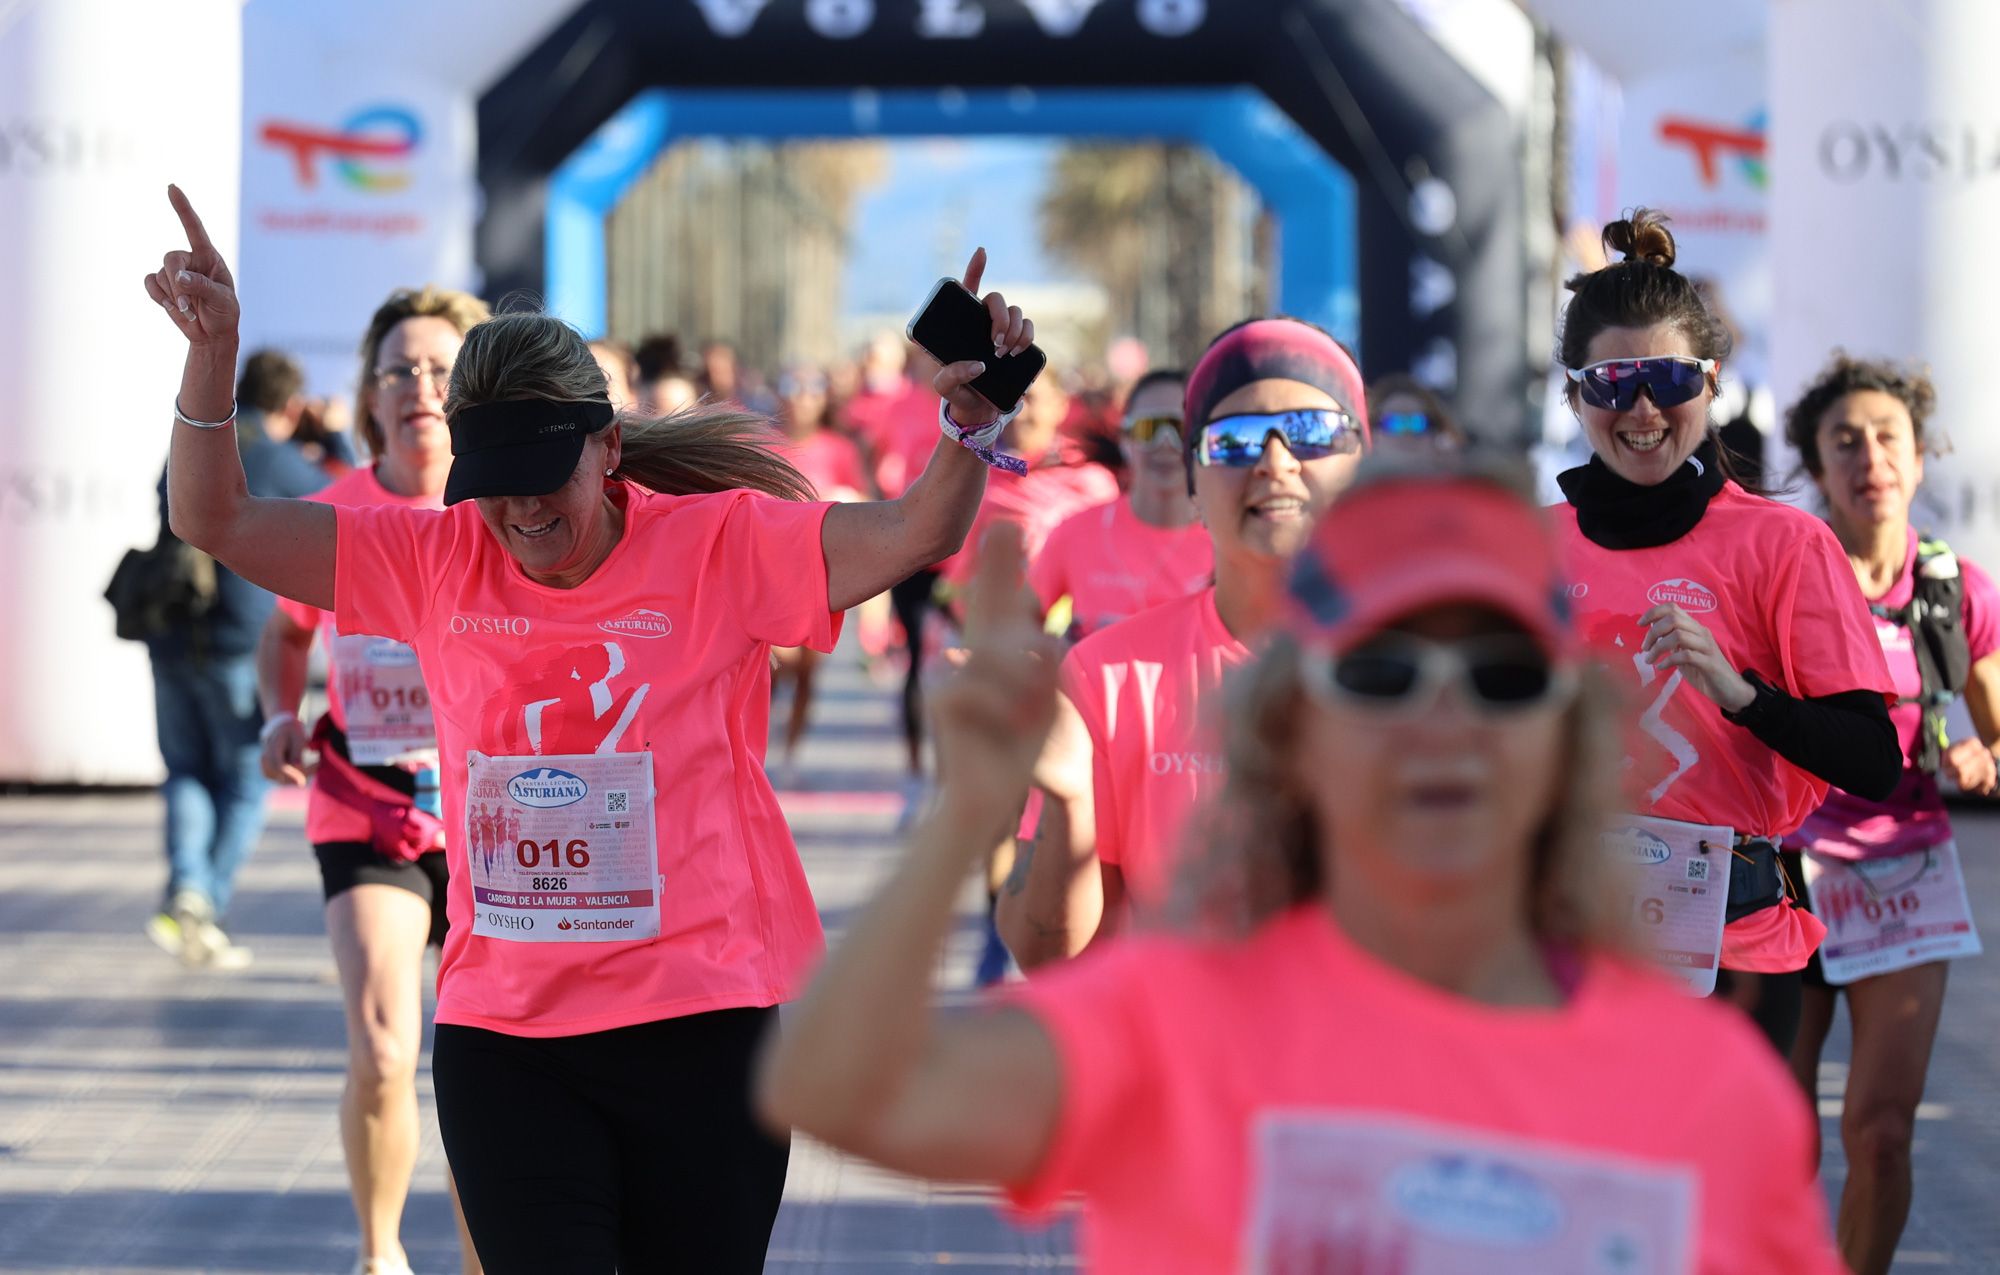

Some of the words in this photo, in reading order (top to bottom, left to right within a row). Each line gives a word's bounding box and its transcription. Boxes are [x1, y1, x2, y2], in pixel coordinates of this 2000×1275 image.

[1653, 588, 1711, 608] ASTURIANA
[450, 616, 530, 635] OYSHO
[604, 620, 666, 632] ASTURIANA
[371, 688, 428, 711] 016
[1150, 752, 1224, 775] OYSH
[514, 782, 581, 798] ASTURIANA
[516, 839, 590, 868] 016
[533, 877, 567, 891] 8626
[487, 893, 516, 905] CARRERA
[519, 896, 530, 905] DE
[533, 896, 544, 905] LA
[547, 896, 577, 906] MUJER
[585, 895, 630, 905] VALENCIA
[1863, 891, 1920, 924] 016
[488, 912, 534, 930] OYSHO
[573, 917, 635, 930] Santander
